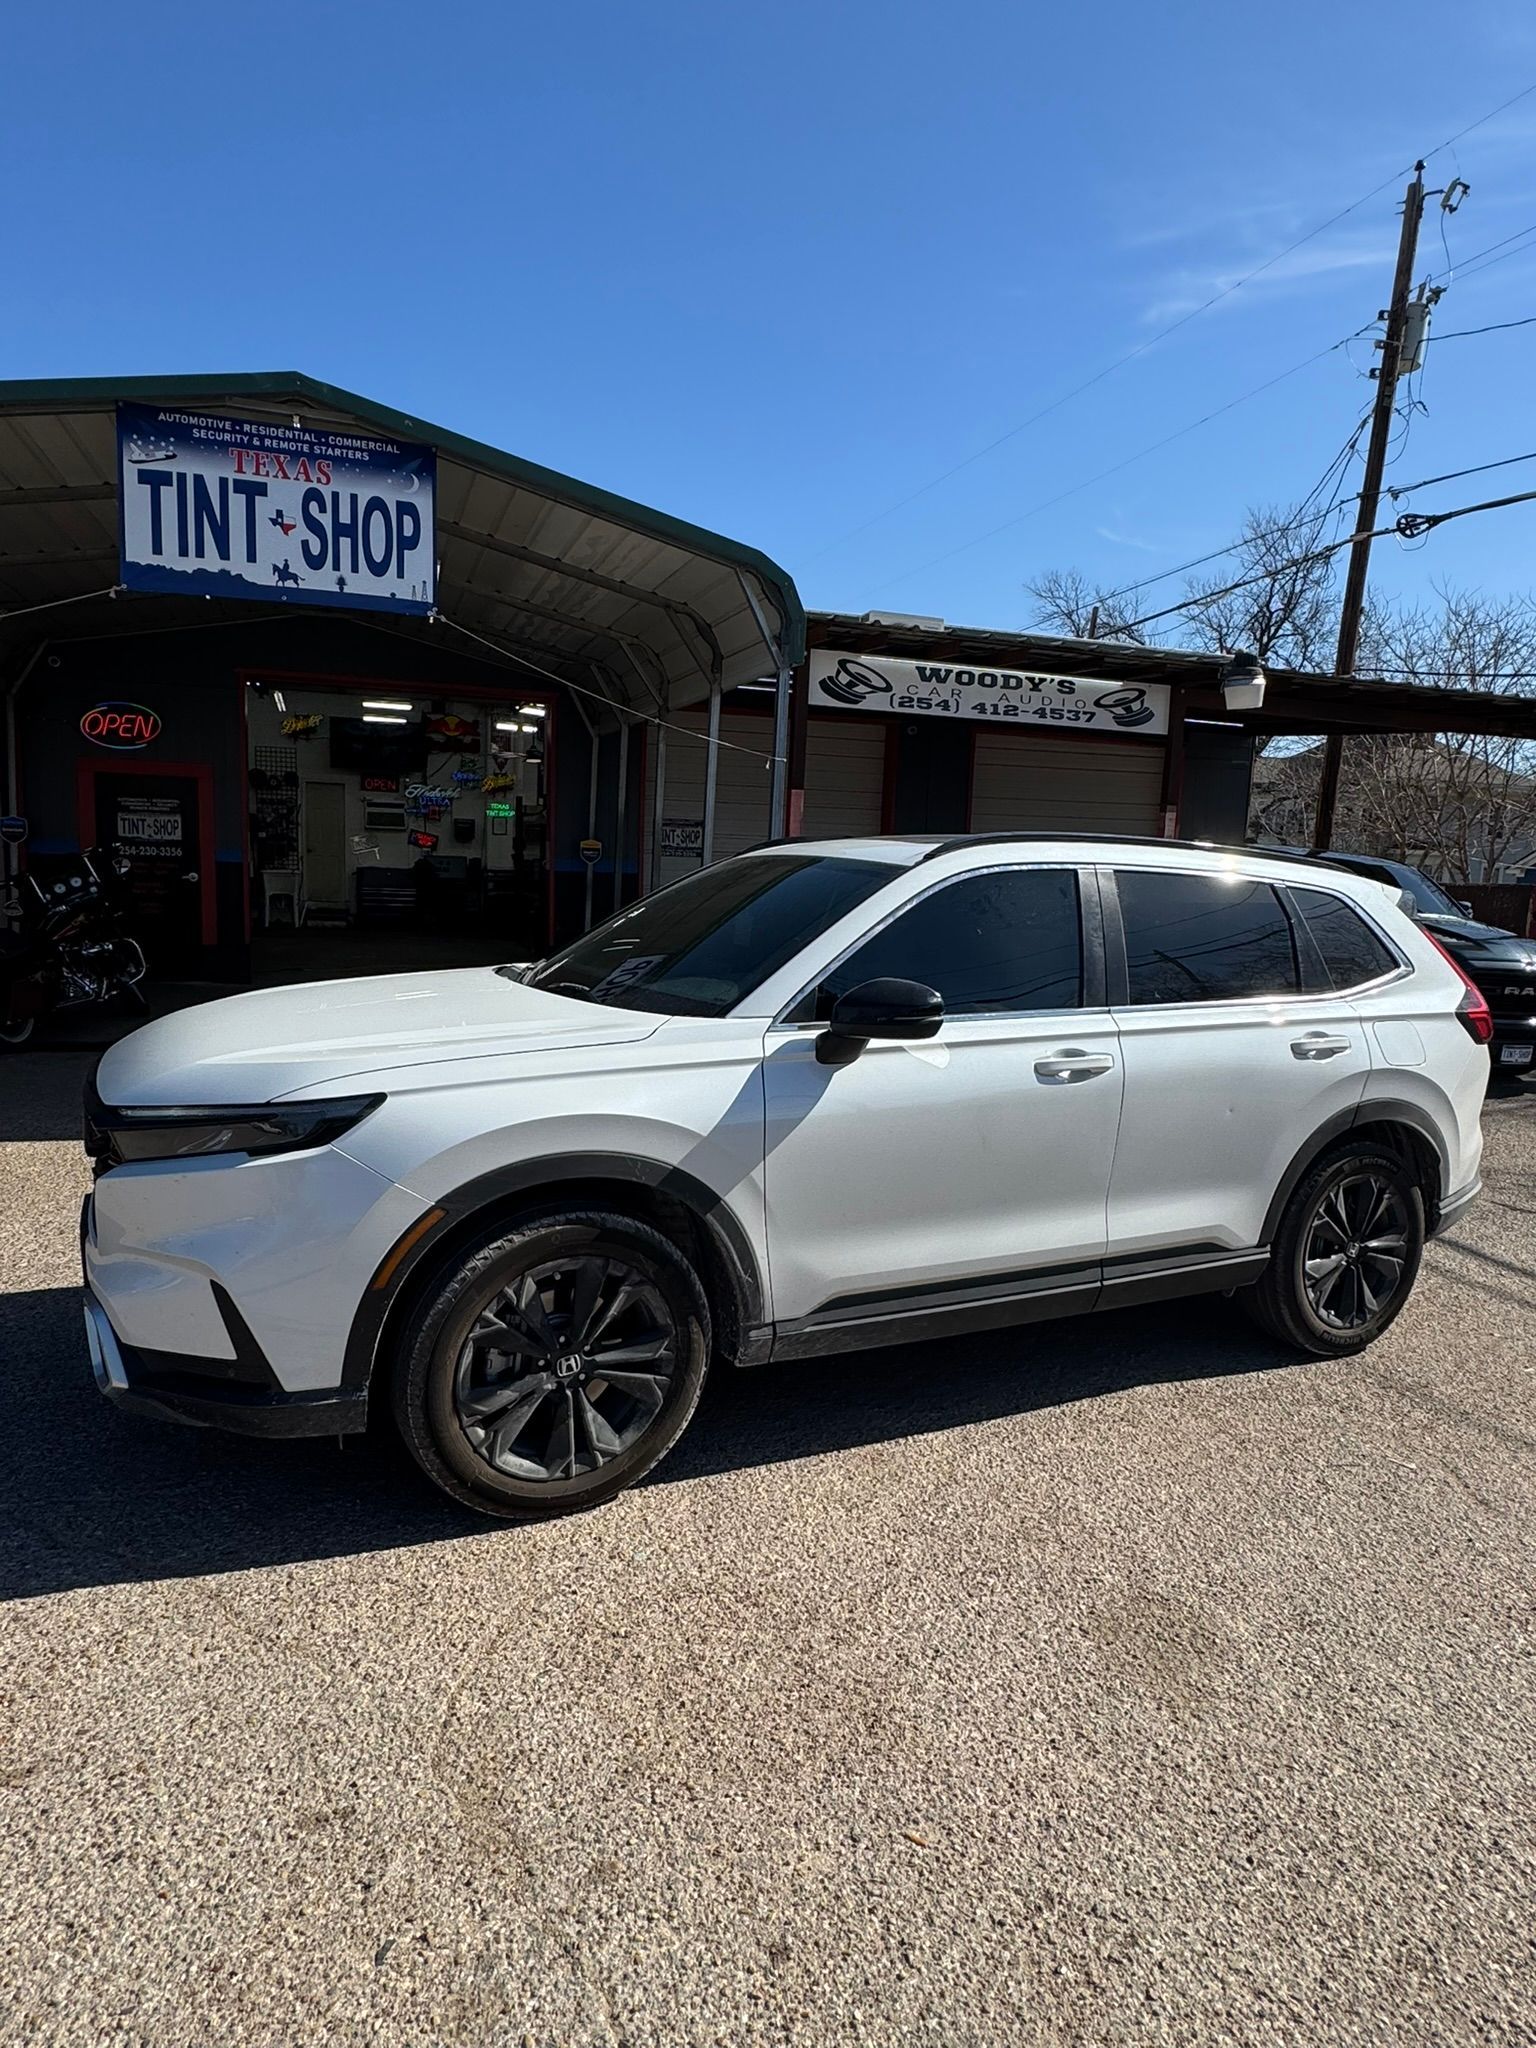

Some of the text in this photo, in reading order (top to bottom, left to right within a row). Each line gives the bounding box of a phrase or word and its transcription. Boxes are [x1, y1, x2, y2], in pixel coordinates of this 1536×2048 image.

[158, 412, 400, 454] AUTOMOTIVE RESIDENTIAL COMMERCIAL
[192, 428, 370, 461] SECURITY & REMOTE STARTERS
[228, 447, 333, 486] TEXAS
[137, 468, 421, 579] TINT SHOP
[915, 665, 1076, 695] WOODY'S
[889, 695, 1097, 723] (254) 412-4537
[906, 684, 1087, 710] CAR AUDIO
[84, 712, 154, 738] OPEN
[365, 779, 396, 791] OPEN
[490, 802, 510, 810] TEXAS
[120, 817, 179, 836] TINT SHOP
[119, 845, 183, 857] 254-230-3356
